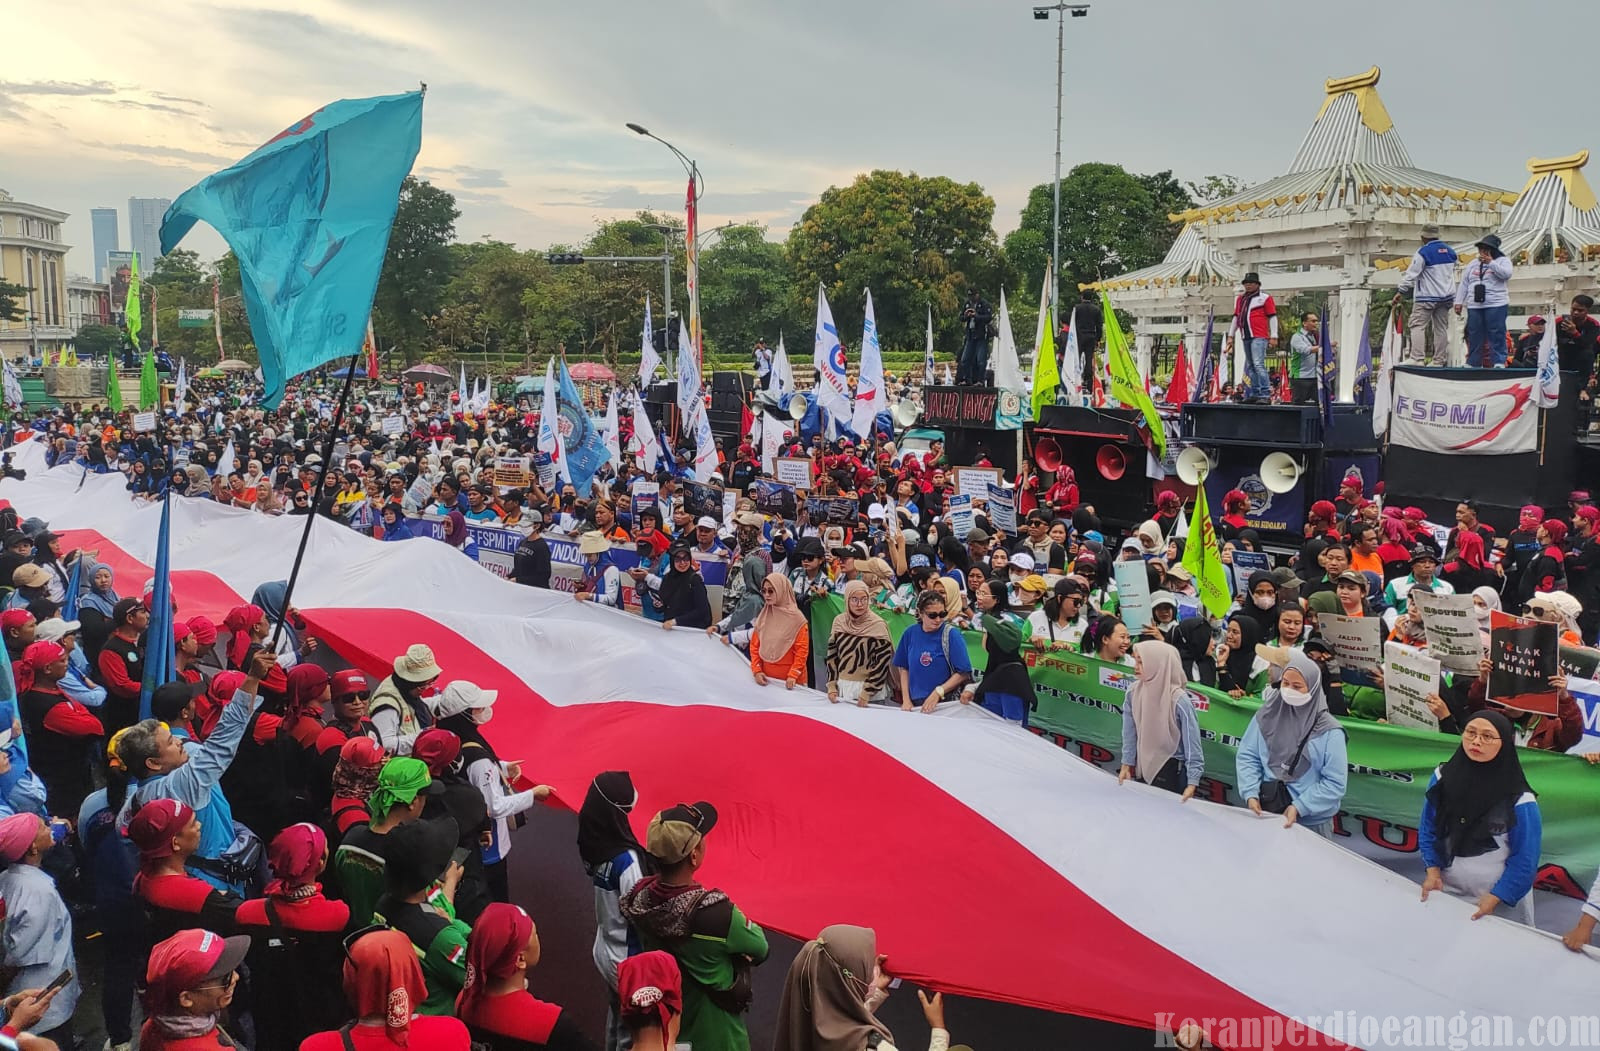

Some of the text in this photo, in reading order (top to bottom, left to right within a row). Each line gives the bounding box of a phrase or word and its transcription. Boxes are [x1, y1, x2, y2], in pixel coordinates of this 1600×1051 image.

[1396, 395, 1487, 425] FSPMI
[477, 530, 506, 550] FSPMI
[551, 543, 588, 564] INDON
[554, 576, 577, 593] 202
[1503, 653, 1535, 667] UPAH
[1498, 663, 1541, 678] MURAH
